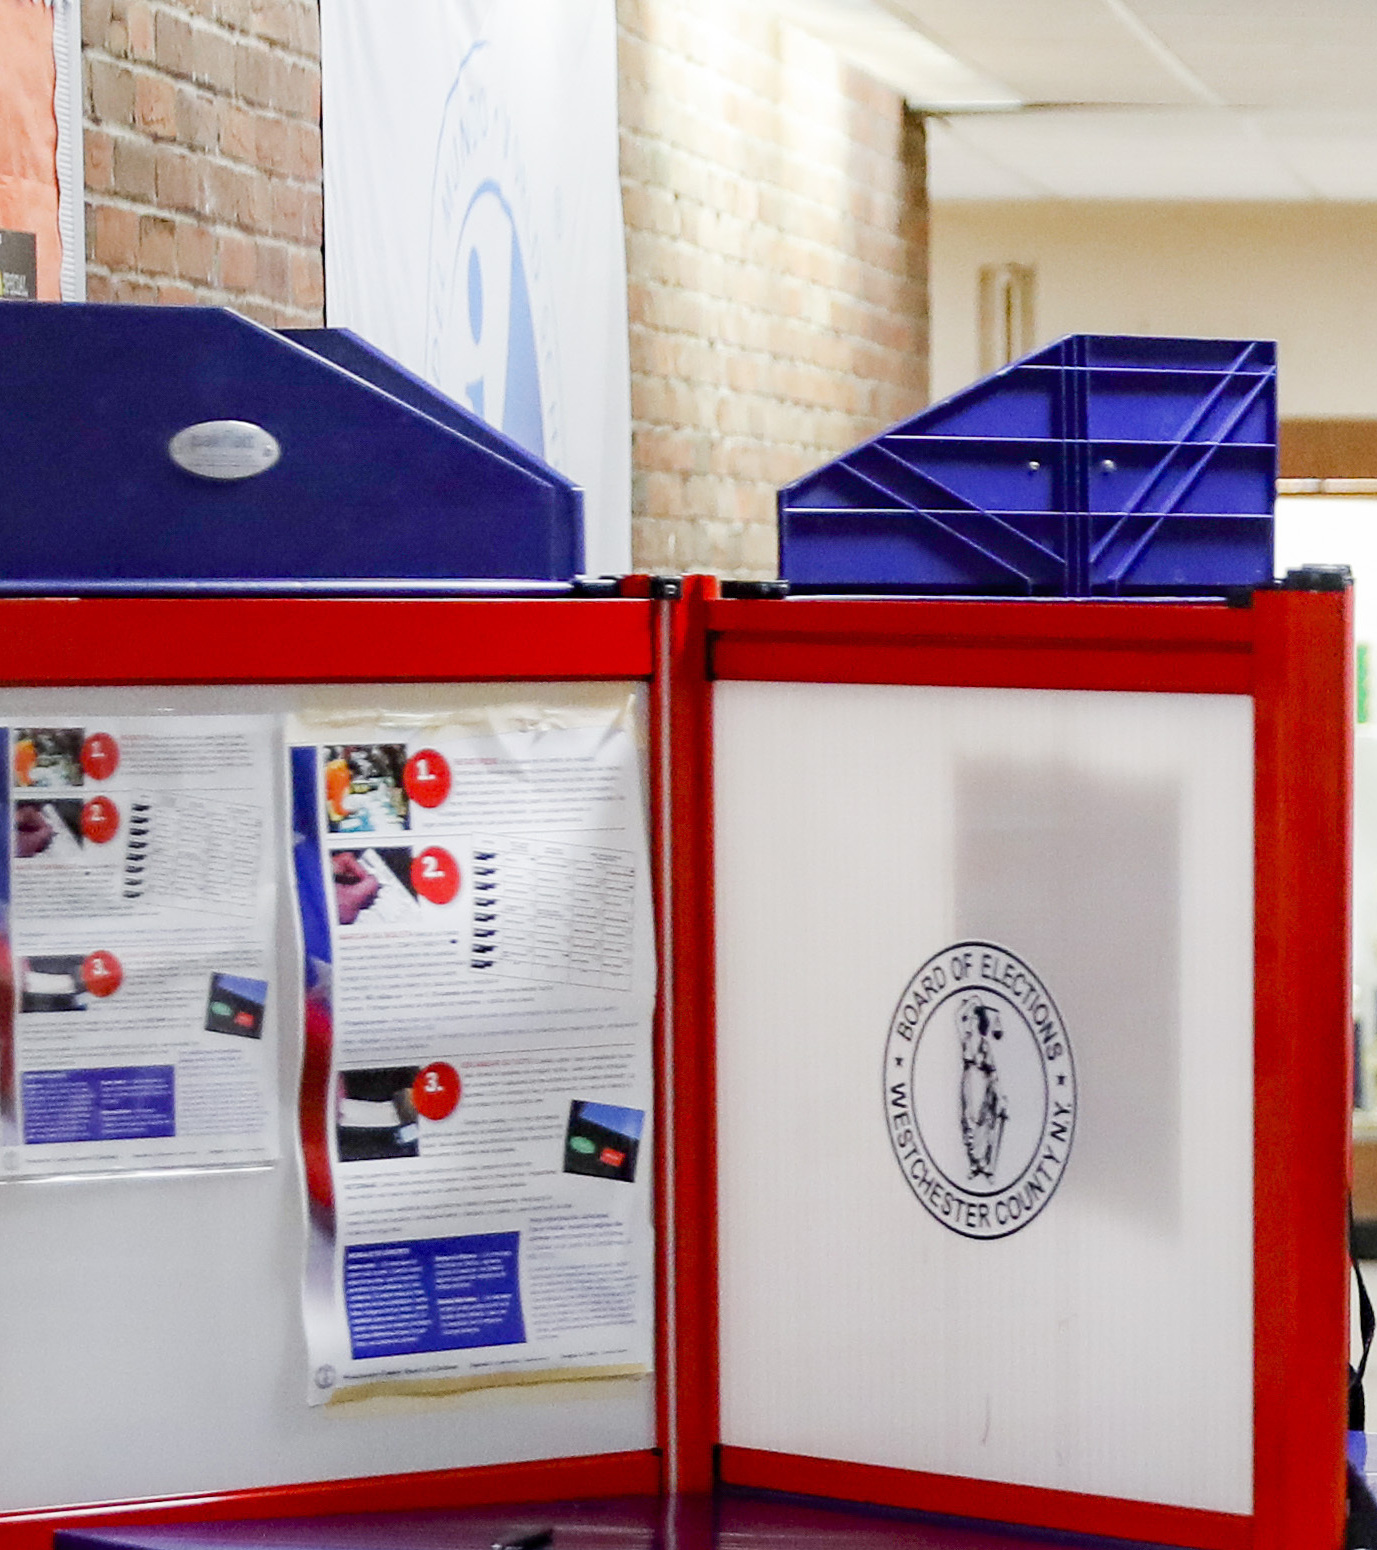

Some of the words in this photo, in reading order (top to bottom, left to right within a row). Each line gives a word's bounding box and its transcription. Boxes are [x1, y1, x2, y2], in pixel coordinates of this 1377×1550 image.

[898, 966, 947, 1042] BOARD
[952, 953, 974, 981] OF
[981, 954, 1064, 1061] ELECTIONS
[890, 1082, 992, 1229] WESTCHESTER
[996, 1144, 1062, 1226] COUNTY
